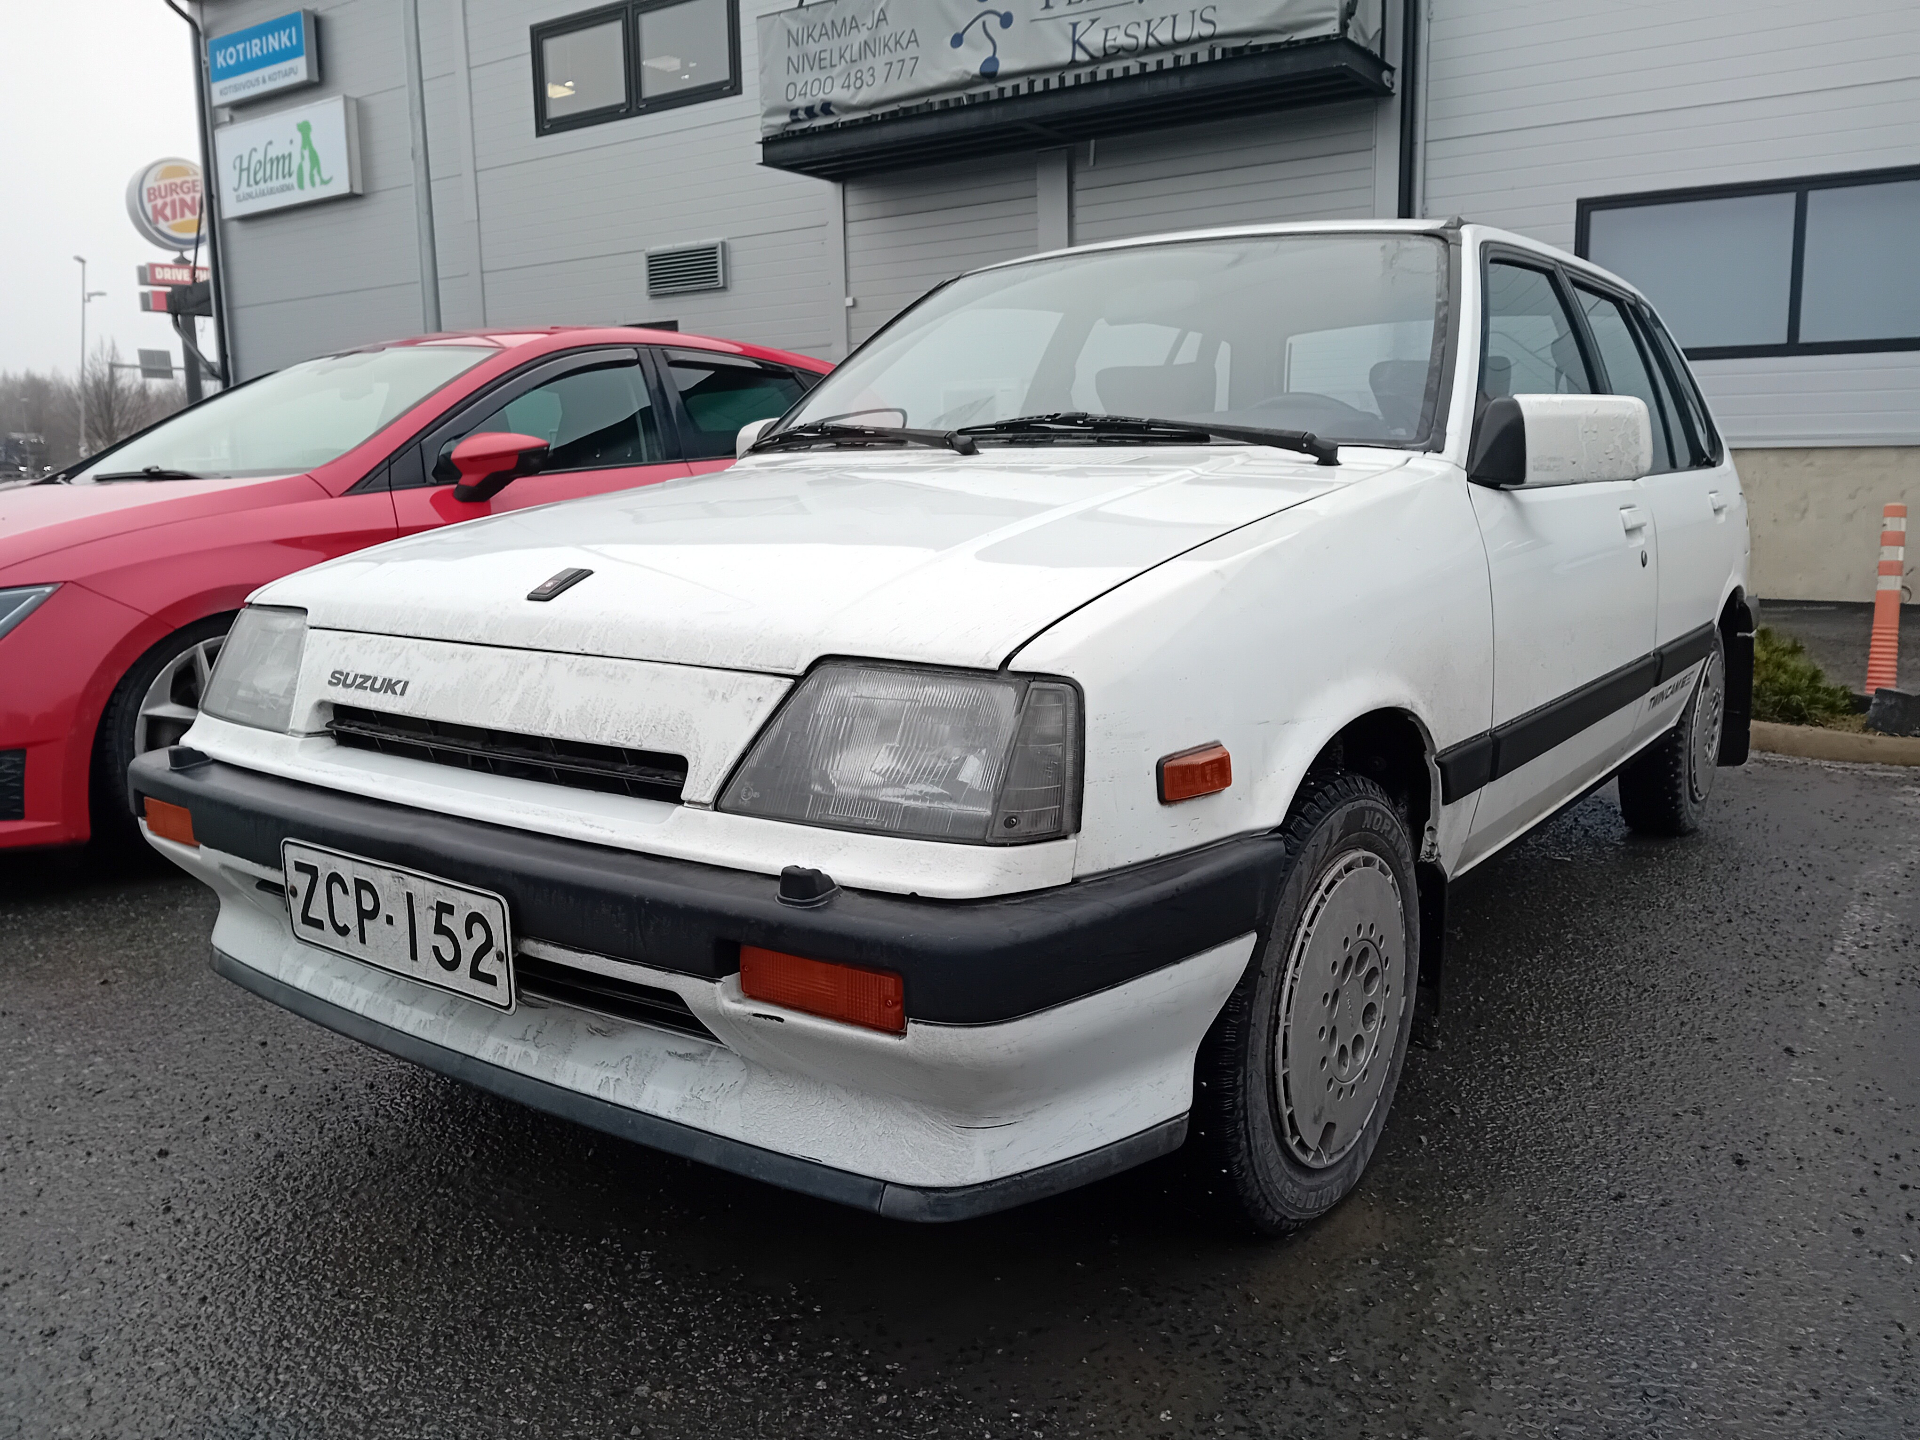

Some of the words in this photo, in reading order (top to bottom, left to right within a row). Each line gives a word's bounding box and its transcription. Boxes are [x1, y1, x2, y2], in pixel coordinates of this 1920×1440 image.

[216, 26, 298, 69] KOTIRINKI
[786, 28, 920, 75] NIVELKLINIKKA
[1068, 5, 1217, 65] KESKUS
[268, 65, 299, 82] KOTIAPU
[785, 75, 835, 102] 0400
[841, 66, 876, 91] 483
[884, 56, 920, 84] 777
[232, 138, 294, 193] Helmi
[147, 180, 200, 203] BURGE
[151, 196, 202, 225] KIN
[155, 266, 190, 282] DRIVE
[328, 670, 410, 697] SUZUKI
[293, 860, 498, 987] ZCP-152
